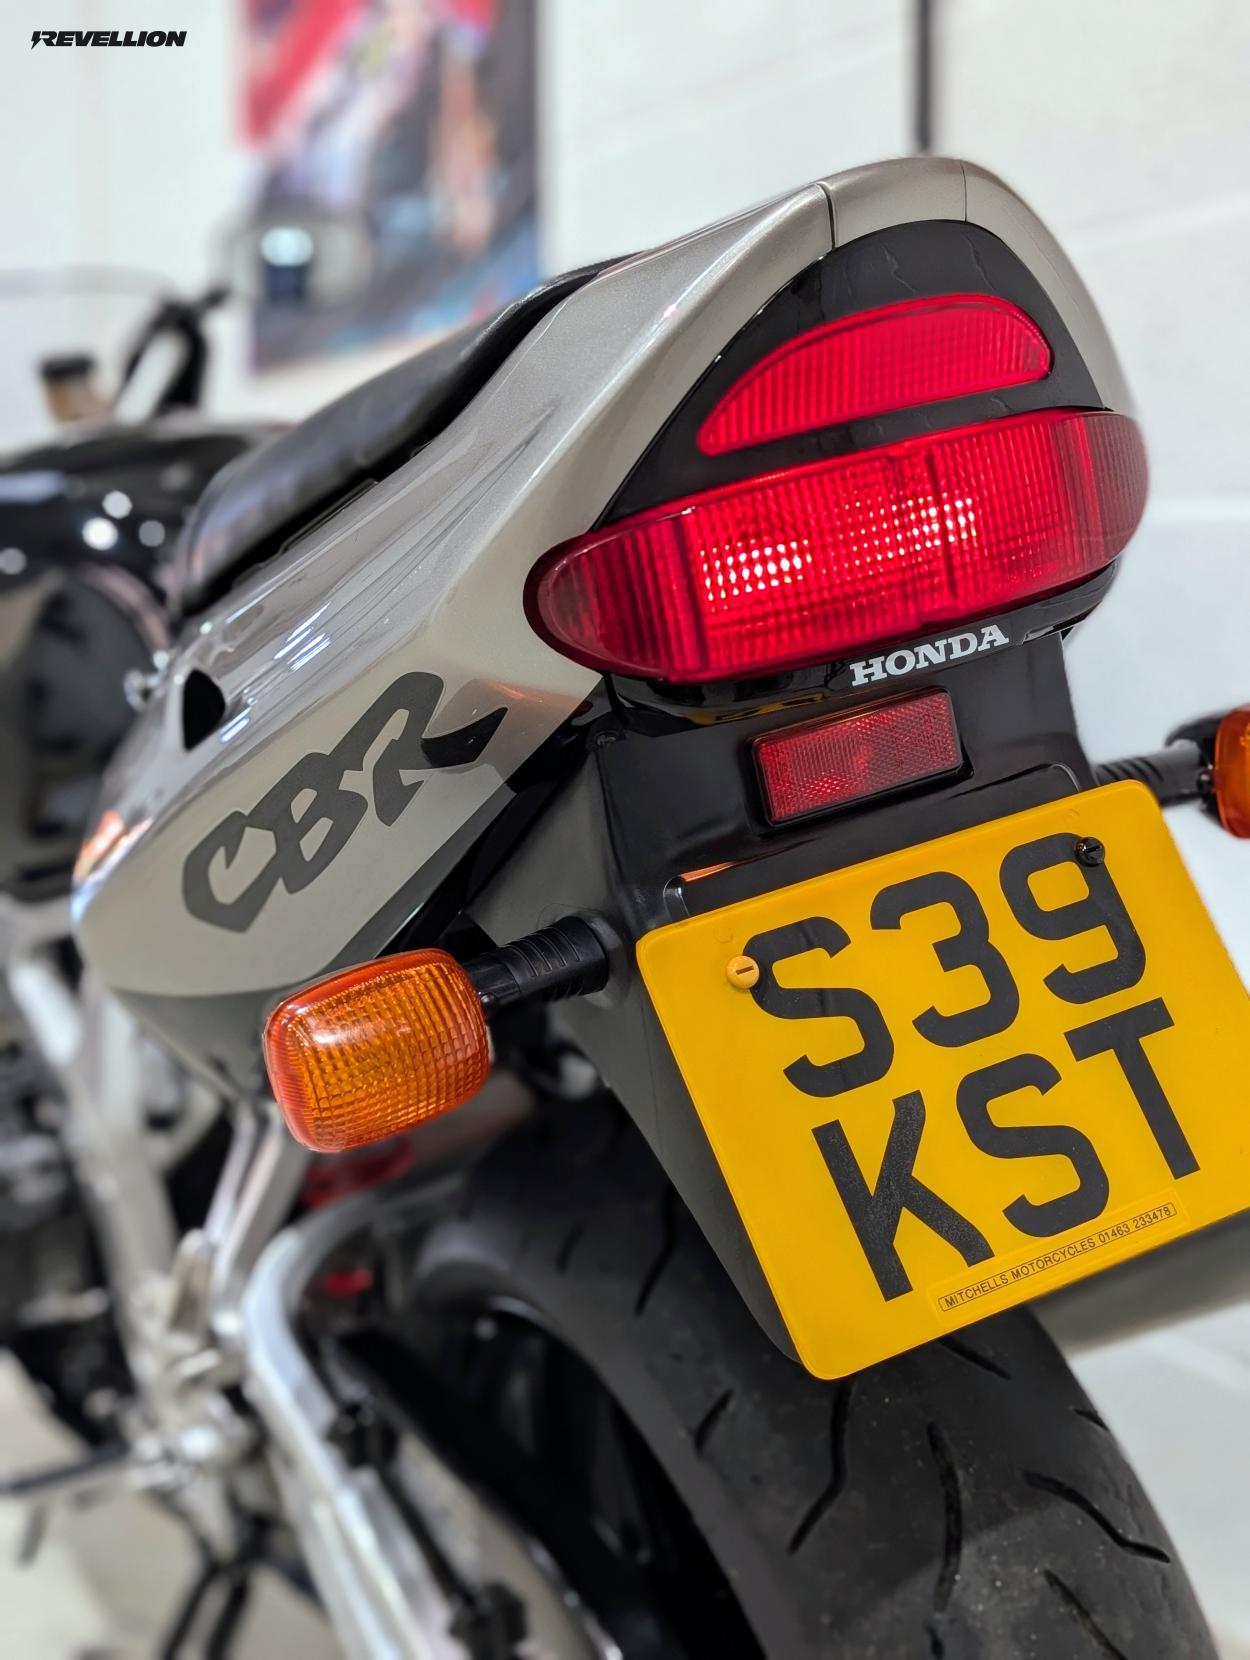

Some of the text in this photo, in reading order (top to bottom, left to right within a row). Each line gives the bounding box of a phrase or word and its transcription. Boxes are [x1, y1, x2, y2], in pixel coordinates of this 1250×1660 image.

[850, 625, 1009, 687] HONDA
[182, 671, 508, 933] CBR
[741, 832, 1147, 1098] S39
[811, 997, 1201, 1302] KST
[944, 1205, 1172, 1308] MITCHELLS MOTORCYCLES 01463 233478
